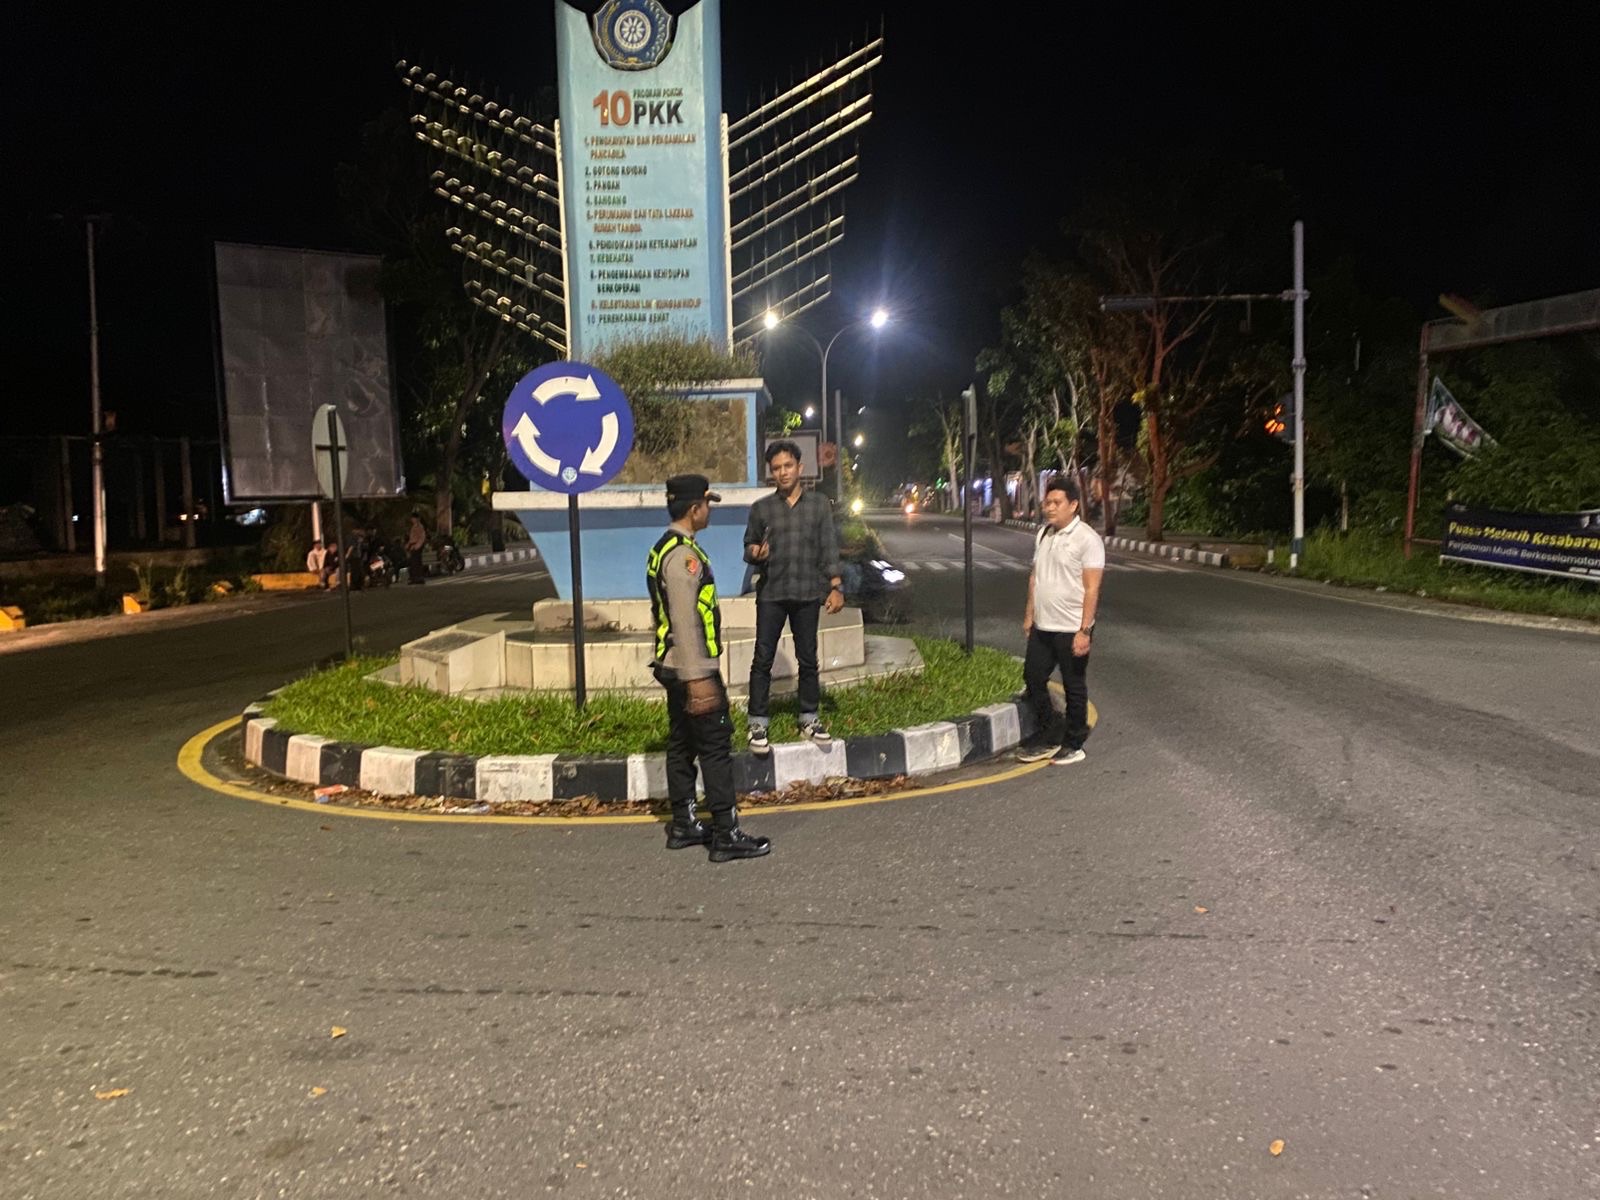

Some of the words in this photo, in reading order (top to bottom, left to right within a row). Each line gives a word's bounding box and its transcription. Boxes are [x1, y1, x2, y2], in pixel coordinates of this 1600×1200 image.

[593, 89, 631, 126] 10
[633, 100, 684, 125] PKK
[592, 166, 620, 176] GOTONG
[621, 166, 648, 176] ROYONG
[593, 180, 621, 191] PANGAN
[1449, 521, 1482, 537] Puasa
[1483, 526, 1530, 544] Melatih
[1448, 540, 1492, 553] Perjalanan
[1492, 545, 1519, 557] Mudik
